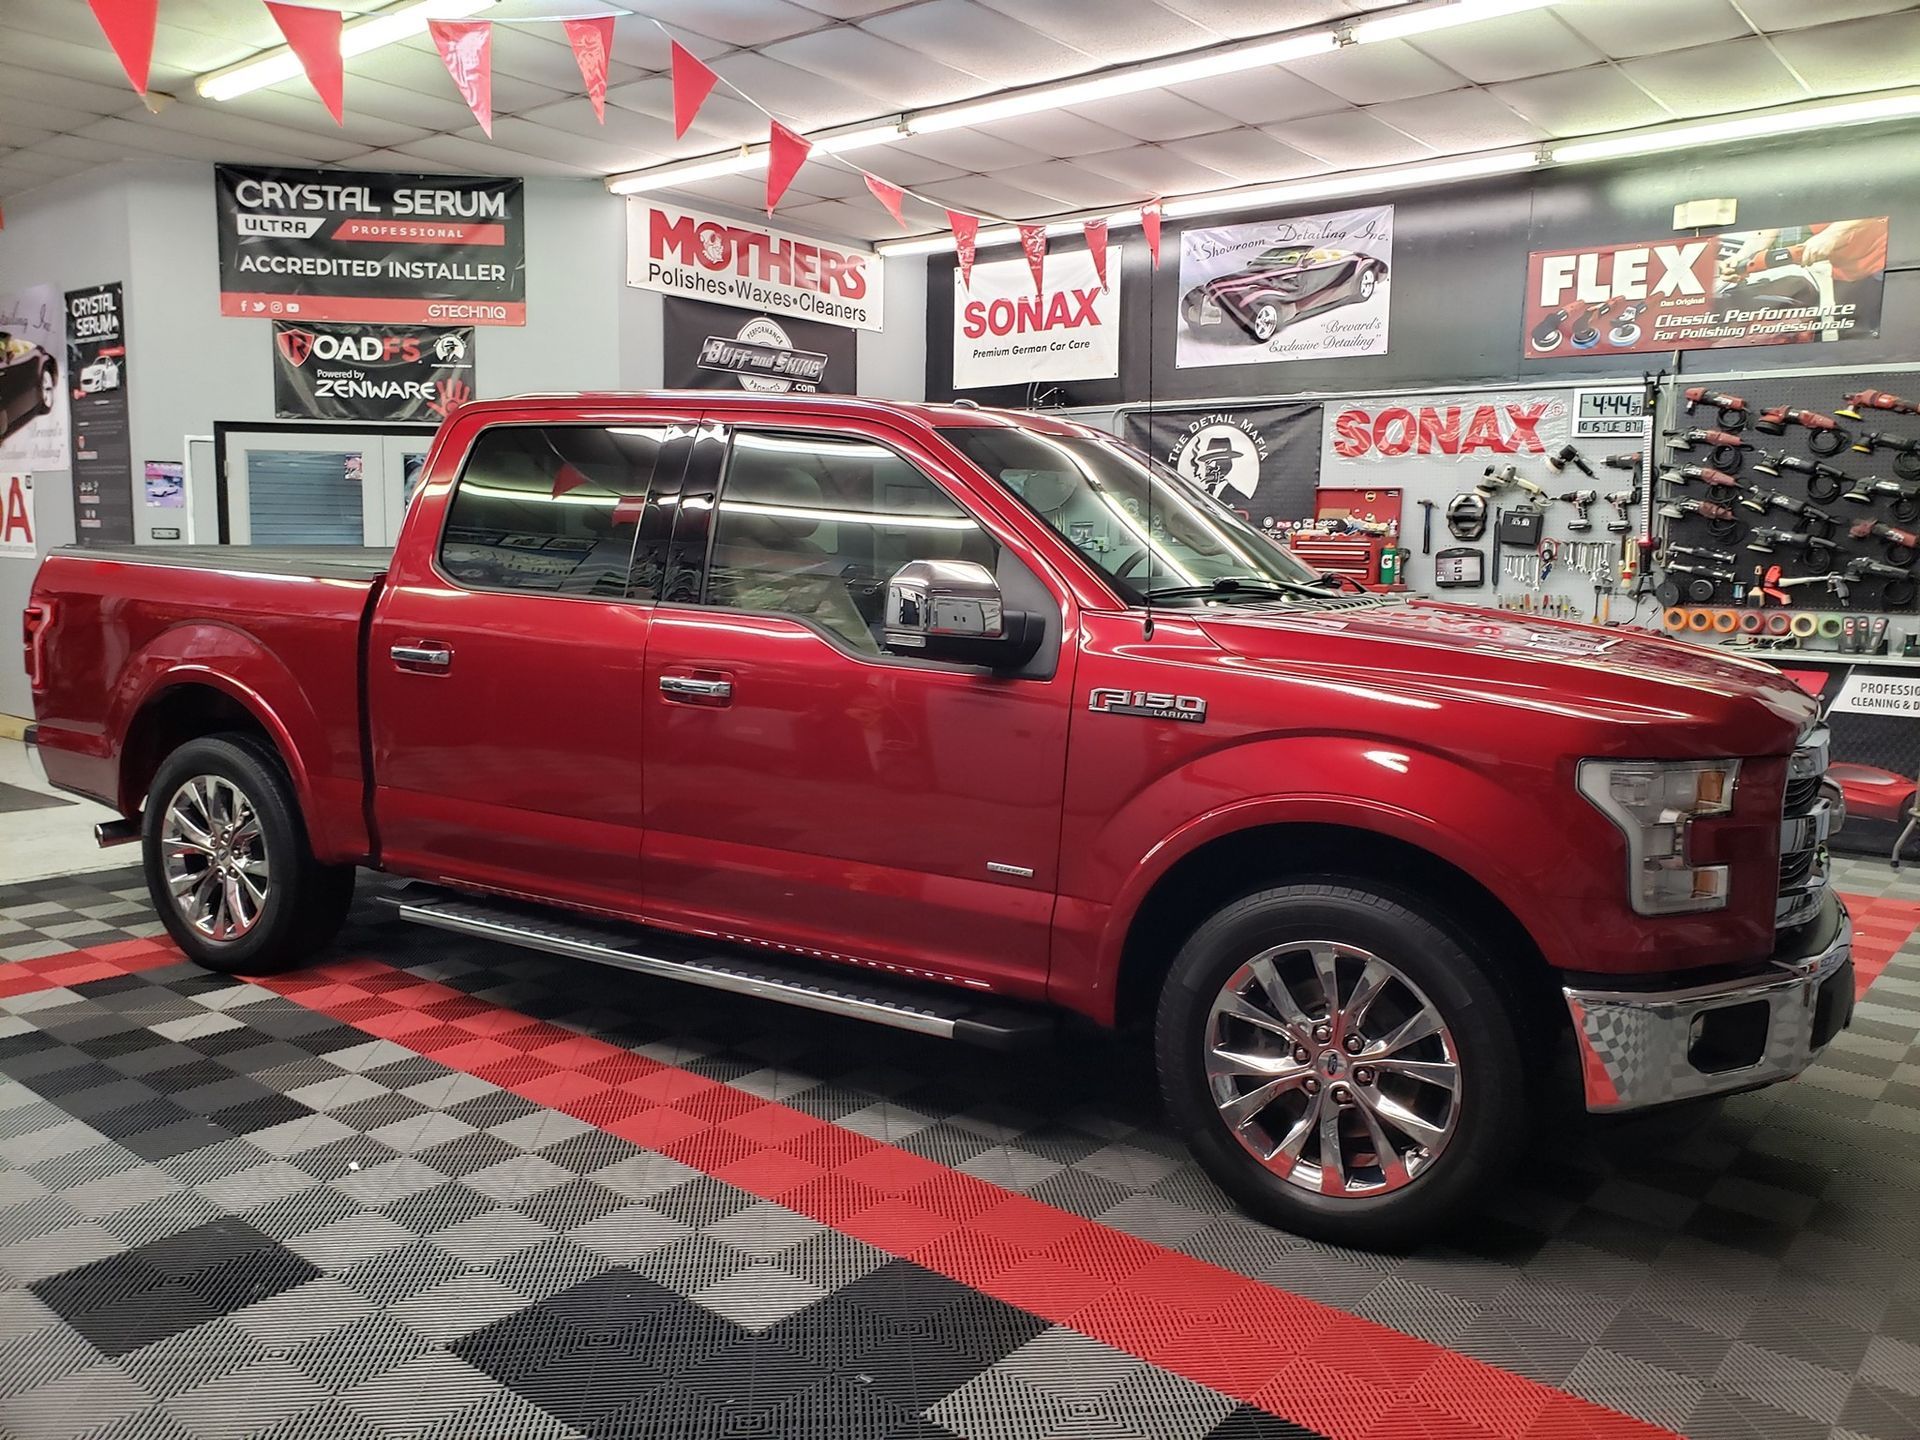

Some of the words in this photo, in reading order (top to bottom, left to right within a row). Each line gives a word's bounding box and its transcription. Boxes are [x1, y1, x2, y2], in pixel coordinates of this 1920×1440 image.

[236, 180, 381, 213] CRYSTAL
[393, 189, 505, 217] SERUM
[245, 218, 307, 233] ULTRA
[351, 225, 464, 239] PROFESSIONAL
[1196, 238, 1265, 262] Showroom
[1275, 220, 1347, 242] Detailing
[1354, 220, 1389, 241] Inc.
[649, 208, 867, 300] MOTHERS
[240, 255, 382, 278] ACCREDITED
[388, 261, 505, 282] INSTALLER
[1541, 242, 1708, 307] FLEX
[649, 262, 727, 296] Polishes
[735, 279, 792, 308] Waxes
[799, 292, 867, 323] Cleaners
[1675, 297, 1705, 306] Original
[71, 293, 117, 318] CRYSTAL
[428, 304, 506, 320] GTECHNIQ
[963, 287, 1102, 339] SONAX
[1654, 311, 1720, 328] Classic
[1724, 304, 1856, 323] Performance
[76, 315, 115, 337] SERUM
[746, 326, 783, 345] PERFORMANCE
[1653, 330, 1675, 341] For
[1679, 325, 1746, 340] Polishing
[1748, 317, 1856, 334] Professionals
[972, 346, 1010, 358] Premium
[1012, 344, 1047, 355] German
[1049, 341, 1066, 351] Car
[1068, 340, 1090, 349] Care
[1268, 339, 1319, 353] Exclusive
[750, 354, 775, 368] and
[317, 369, 353, 379] Powered
[354, 370, 365, 381] by
[314, 380, 436, 400] ZENWARE
[792, 384, 816, 393] .com
[1593, 395, 1633, 415] 4:44
[1168, 434, 1189, 463] THE
[1189, 413, 1236, 434] DETAIL
[1240, 418, 1270, 462] MAFIA
[1334, 403, 1550, 457] SONAX
[1851, 696, 1900, 709] CLEANING
[1902, 700, 1911, 710] &
[1153, 709, 1196, 720] LARIAT
